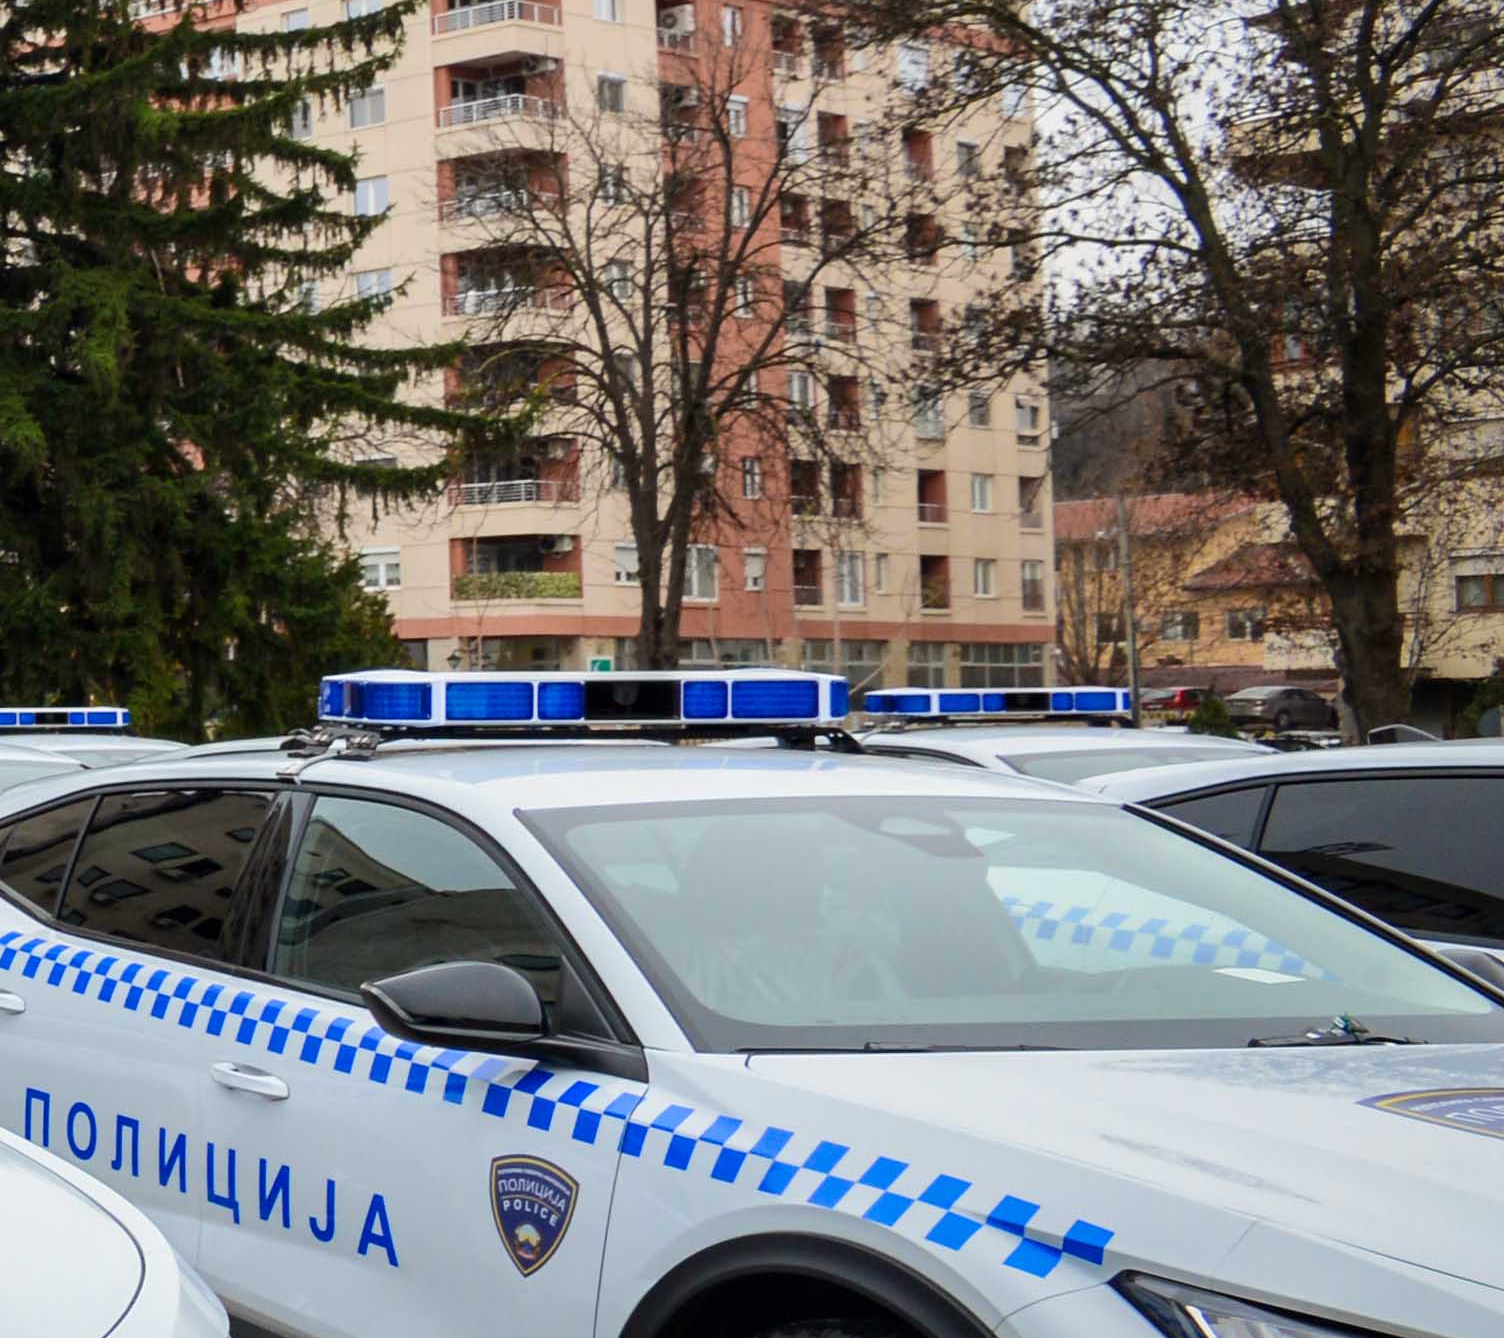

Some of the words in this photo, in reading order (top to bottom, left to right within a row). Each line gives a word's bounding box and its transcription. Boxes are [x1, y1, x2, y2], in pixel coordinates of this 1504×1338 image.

[24, 1087, 400, 1268] ПОЛИЦИЈА
[498, 1178, 566, 1213] ПОЛИЦИЈА
[503, 1199, 559, 1227] POLICE
